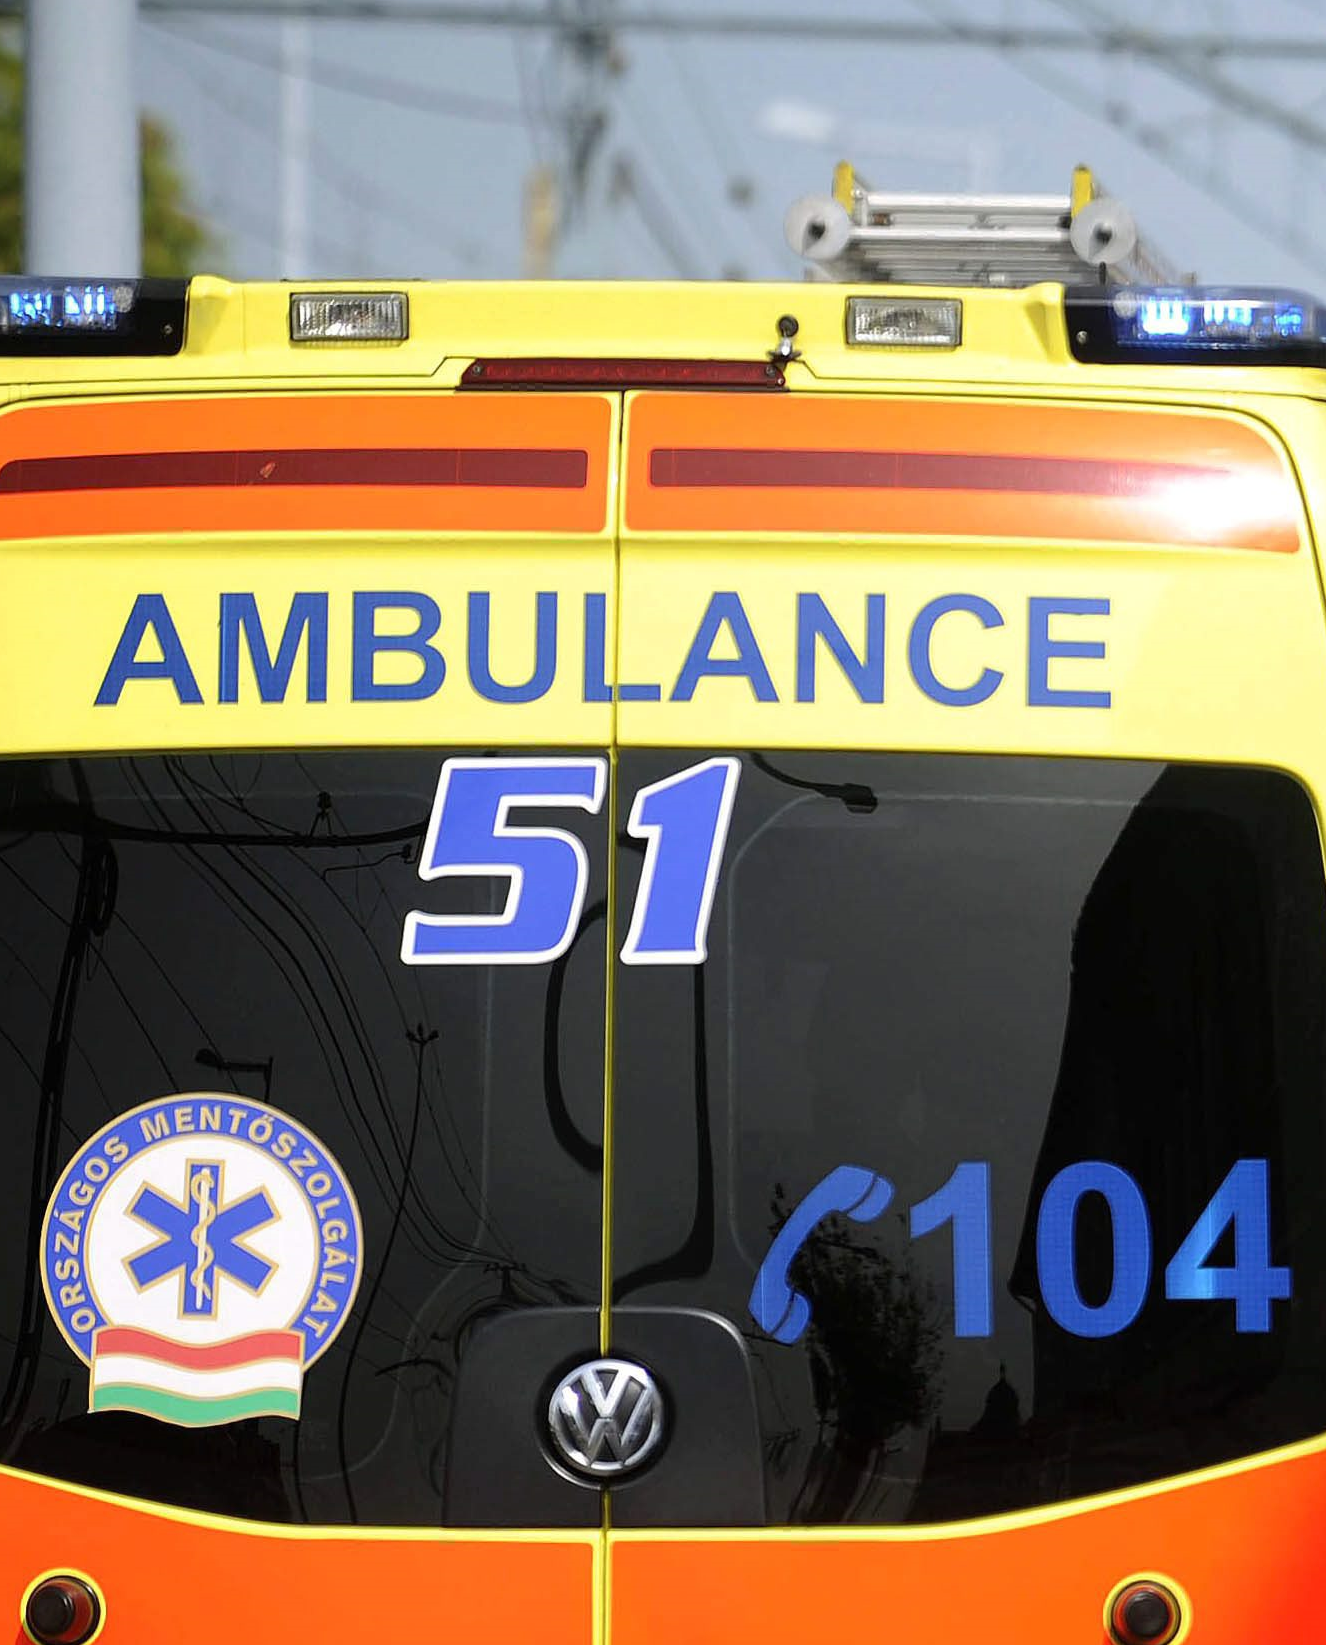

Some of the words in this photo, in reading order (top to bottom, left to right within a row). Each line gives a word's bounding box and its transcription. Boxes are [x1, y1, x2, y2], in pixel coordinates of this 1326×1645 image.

[93, 591, 1111, 709] AMBULANCE
[400, 757, 742, 966] 51
[54, 1136, 131, 1334] ORSZÁGOS
[139, 1105, 356, 1339] MENTŐSZOLGÁLAT
[909, 1159, 1291, 1338] 104
